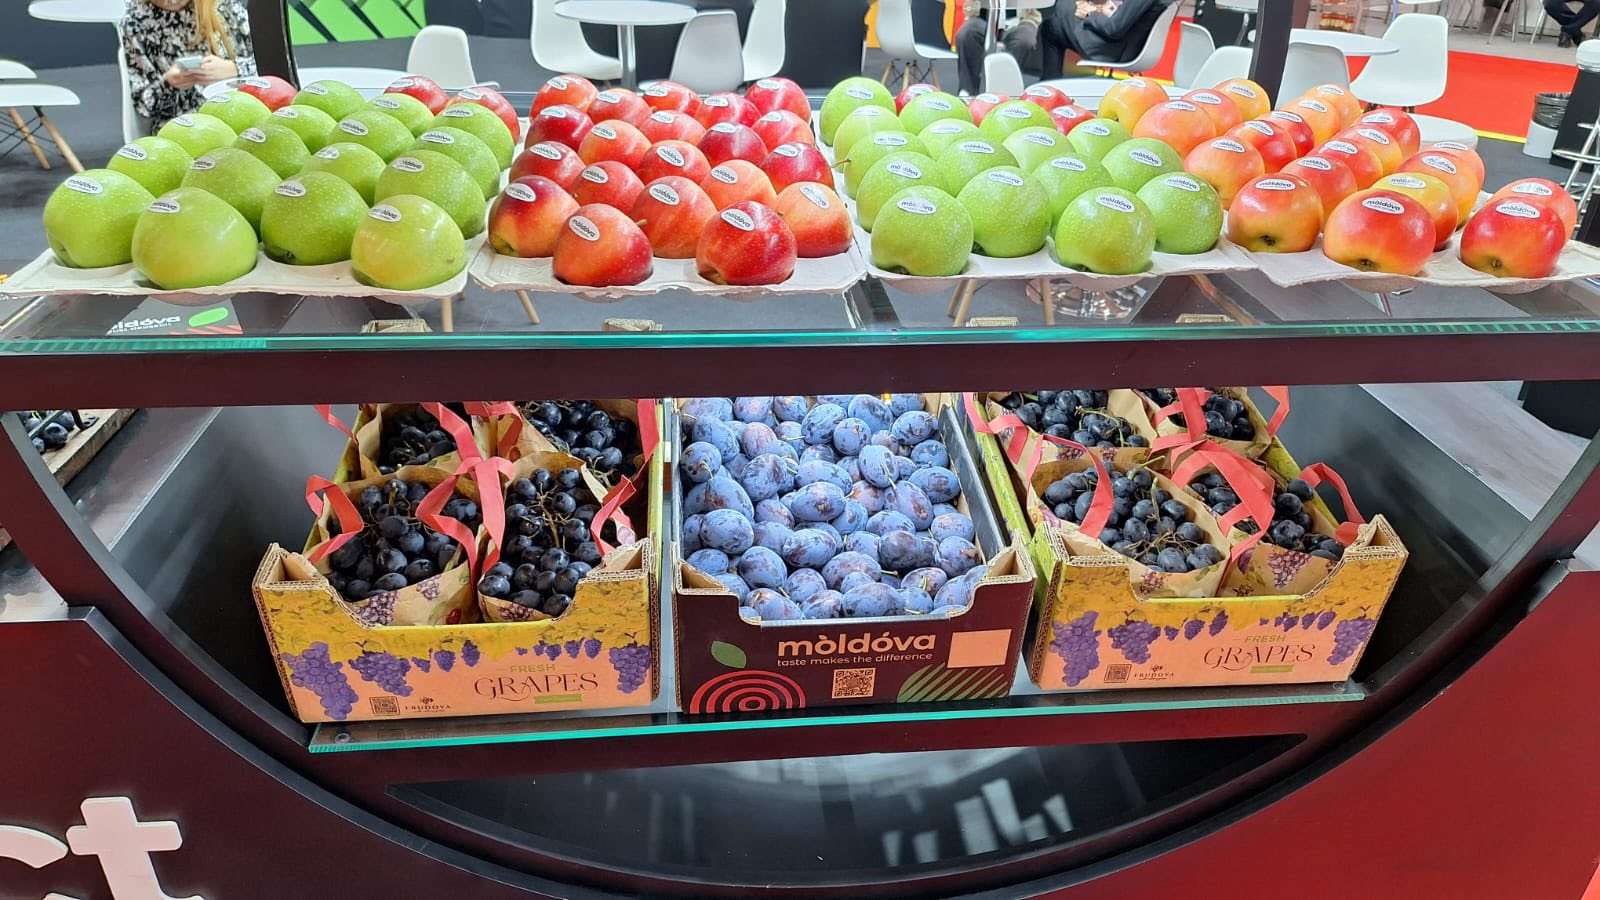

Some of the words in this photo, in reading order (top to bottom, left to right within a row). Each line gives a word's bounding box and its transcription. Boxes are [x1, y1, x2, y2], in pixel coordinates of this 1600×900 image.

[778, 631, 936, 656] mòldóva
[1245, 635, 1286, 643] FRESH
[777, 658, 807, 667] taste
[810, 656, 850, 665] makes
[853, 655, 873, 663] the
[875, 653, 933, 662] difference
[1203, 644, 1315, 671] GRAPES
[510, 664, 556, 673] FRESH
[474, 672, 599, 702] GRAPES
